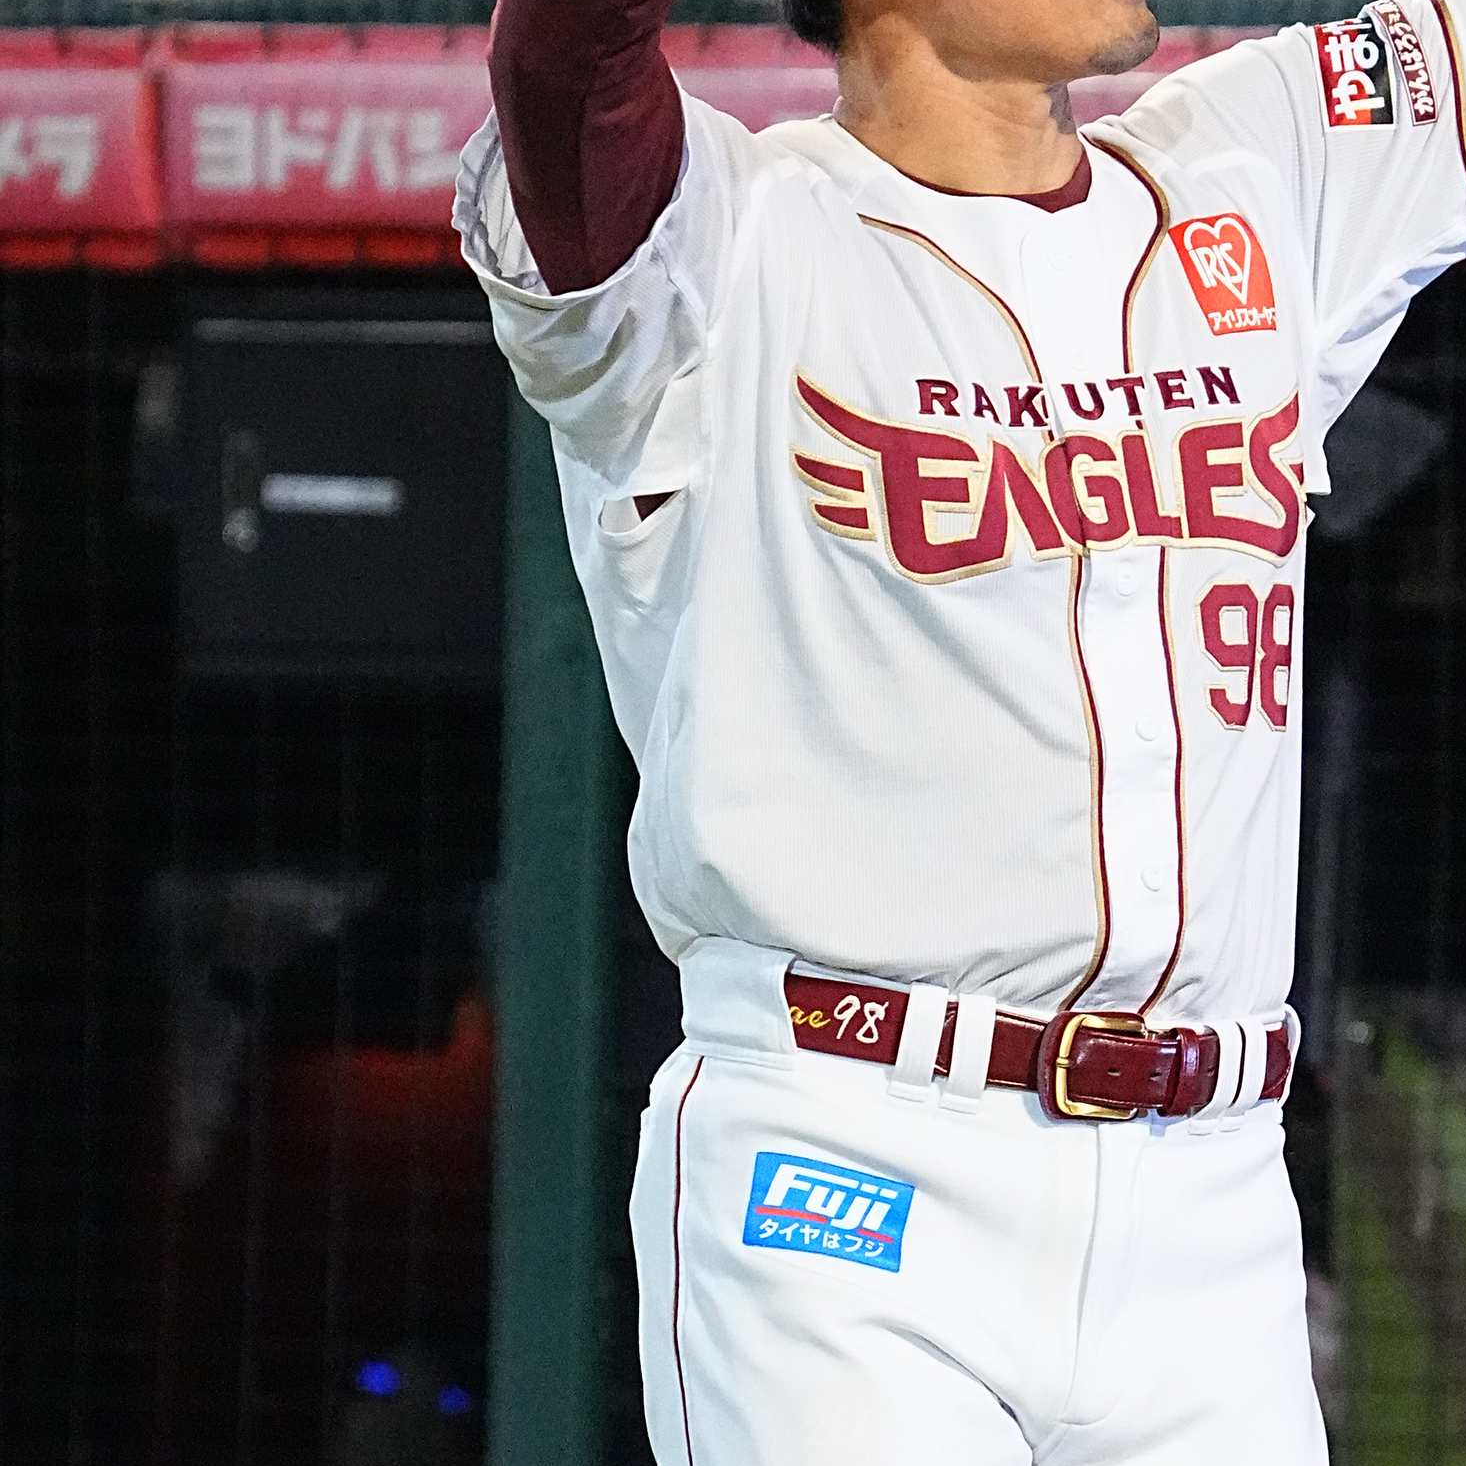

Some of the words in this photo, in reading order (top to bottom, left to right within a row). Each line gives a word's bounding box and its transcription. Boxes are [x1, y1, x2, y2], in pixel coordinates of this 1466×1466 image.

[1187, 241, 1245, 289] IRIS
[915, 366, 1241, 428] RAKUTEN
[790, 378, 1304, 585] EAGLES
[1196, 580, 1295, 732] 98
[763, 1163, 899, 1232] Fuji
[759, 1218, 885, 1258] タイヤはフジ
